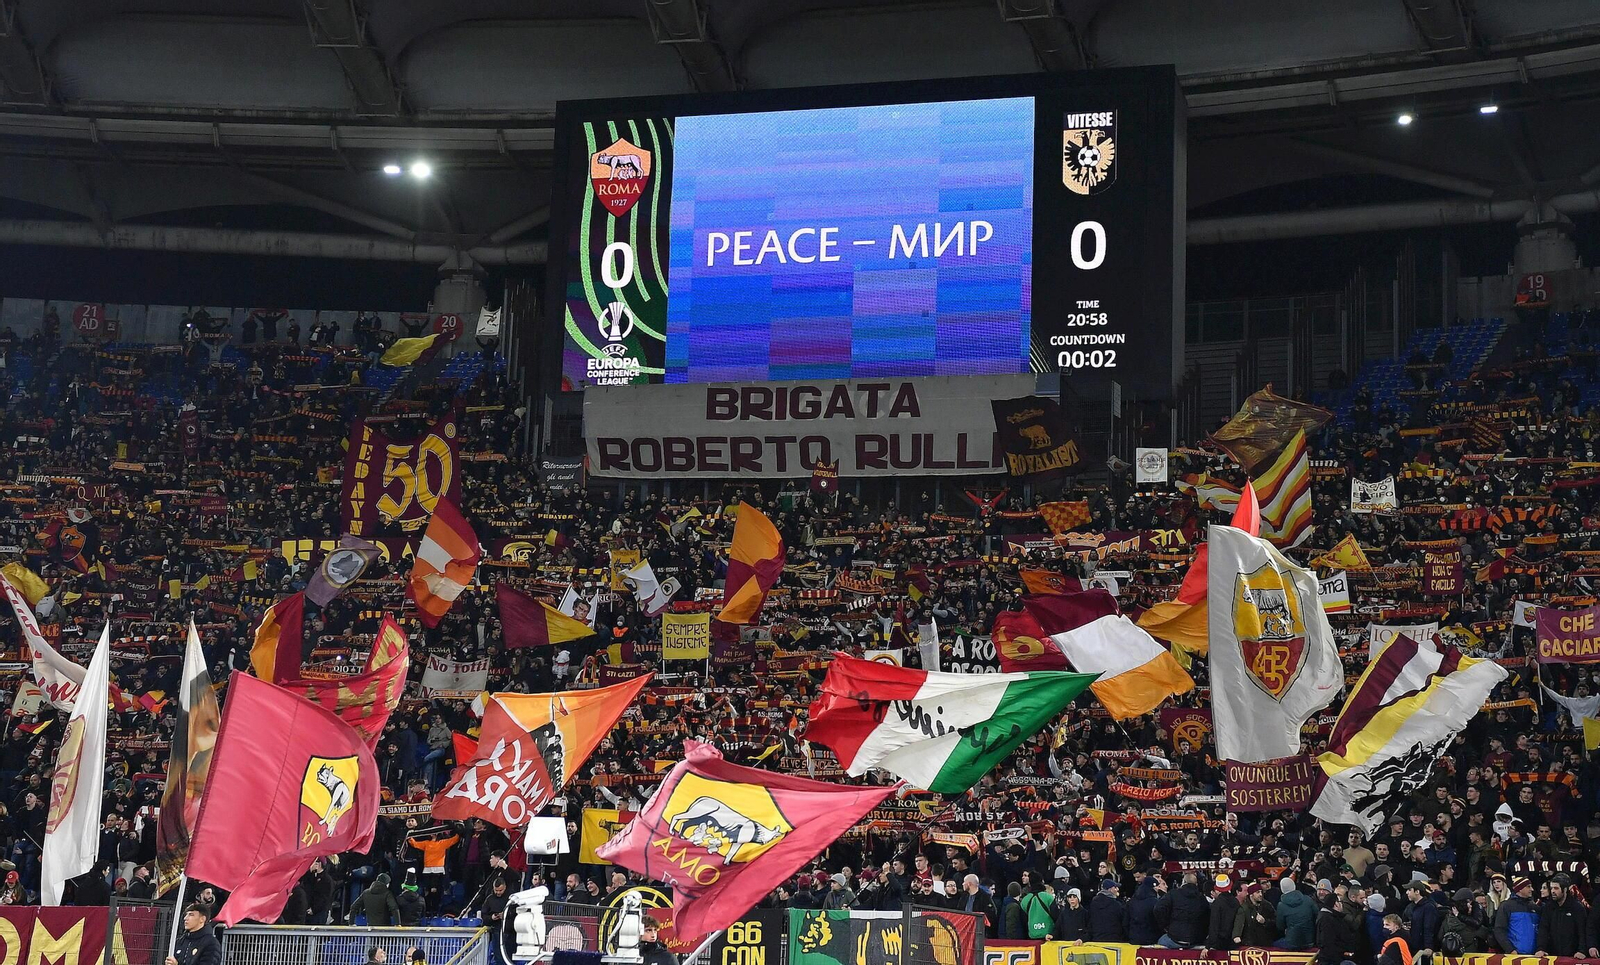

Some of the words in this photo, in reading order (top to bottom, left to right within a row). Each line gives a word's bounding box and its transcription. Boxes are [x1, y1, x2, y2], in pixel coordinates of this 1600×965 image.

[1066, 111, 1113, 129] VITESSE
[598, 181, 641, 198] ROMA
[610, 199, 628, 208] 1927
[707, 226, 841, 267] PEACE
[888, 219, 994, 261] МИР
[1071, 220, 1107, 271] 0
[601, 241, 634, 289] 0
[1527, 274, 1545, 288] 19
[82, 304, 98, 317] 21
[1076, 299, 1101, 310] TIME
[79, 317, 99, 330] AD
[441, 315, 457, 328] 20
[1066, 311, 1109, 327] 20:58
[1050, 332, 1126, 346] COUNTDOWN
[601, 343, 629, 357] UEFA
[586, 357, 640, 370] EUROPA
[1057, 349, 1117, 369] 00:02
[586, 368, 640, 378] CONFERENCE
[597, 376, 634, 386] LEAGUE
[706, 382, 921, 422] BRIGATA
[599, 434, 838, 472] ROBERTO
[666, 622, 707, 635] SEMPRE
[1559, 613, 1595, 633] CHE
[666, 636, 707, 649] INSIEME
[971, 638, 997, 660] RO
[428, 657, 448, 673] No
[1099, 750, 1130, 758] ROMA
[1230, 764, 1291, 784] OVUNQUE
[1294, 762, 1308, 780] TI
[387, 806, 408, 814] SIAMO
[409, 805, 418, 813] LA
[419, 804, 432, 812] ROM
[898, 799, 920, 808] ROM
[1145, 808, 1197, 817] ROMA
[1171, 821, 1200, 830] ROMA
[727, 920, 763, 945] 66
